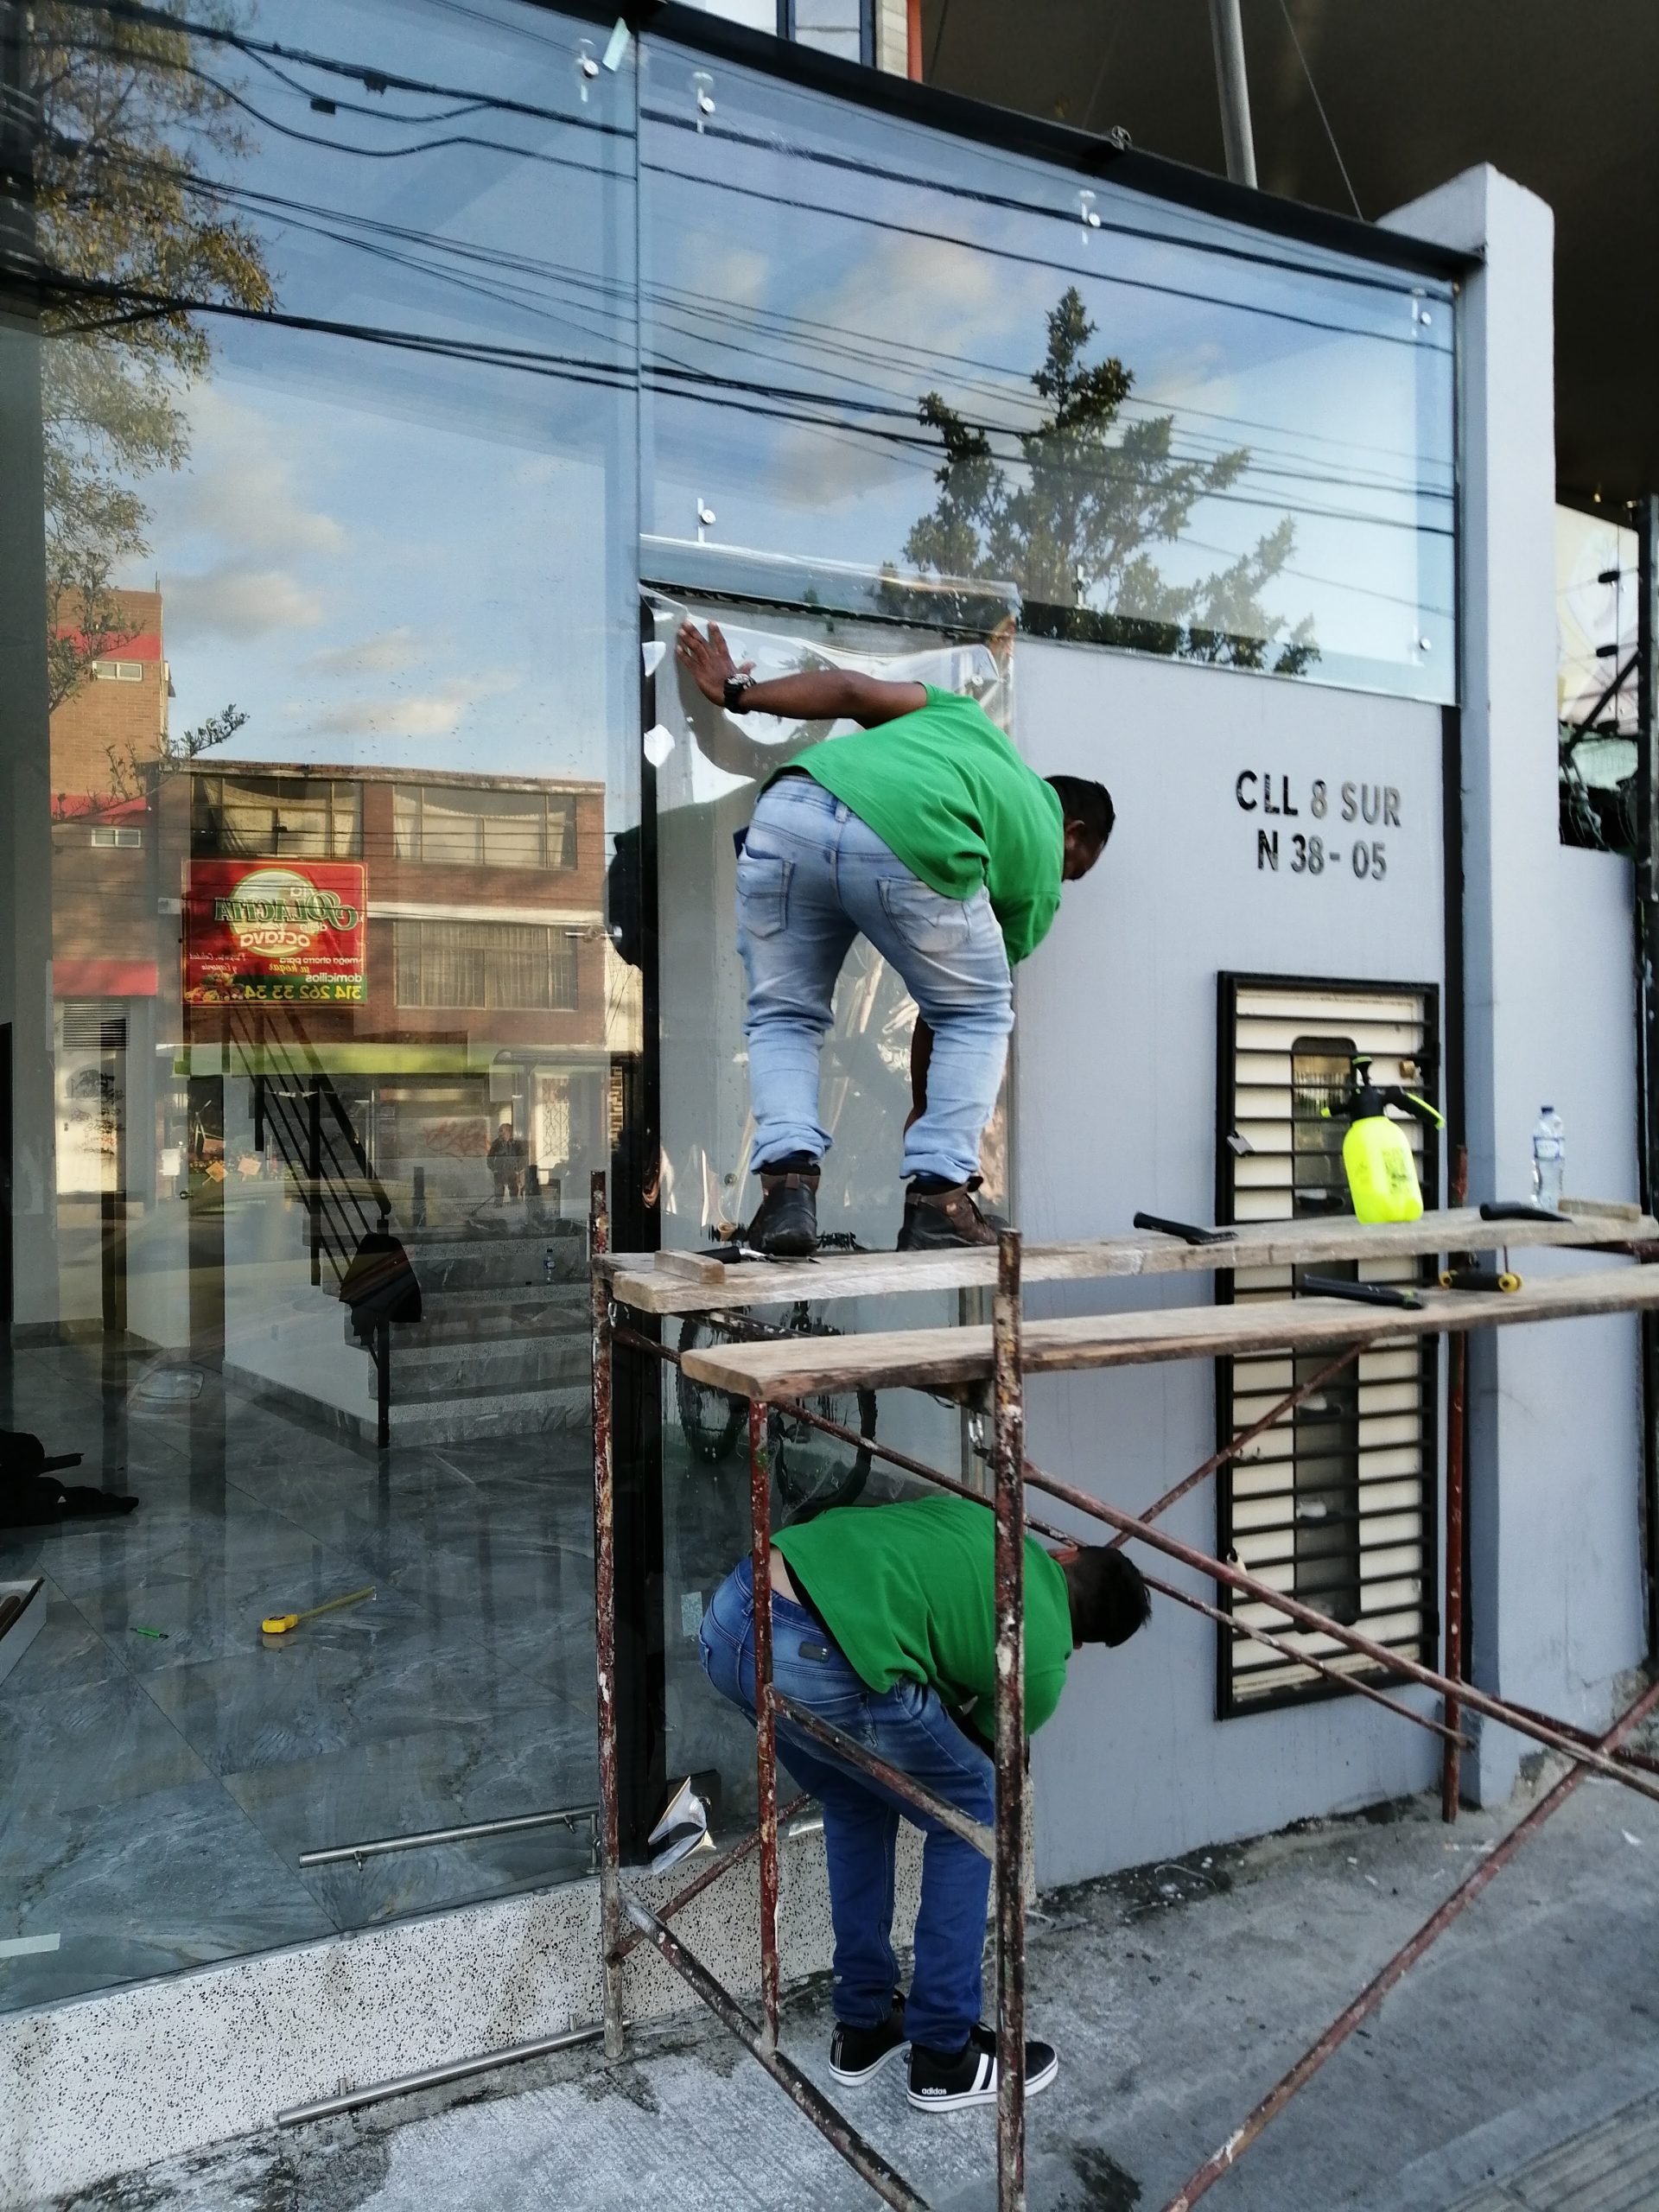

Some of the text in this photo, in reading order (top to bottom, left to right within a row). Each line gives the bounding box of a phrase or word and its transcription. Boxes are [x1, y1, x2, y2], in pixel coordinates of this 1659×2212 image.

[1236, 769, 1402, 828] CLL 8 SUR
[1257, 828, 1279, 871] N
[921, 2087, 947, 2095] adidas
